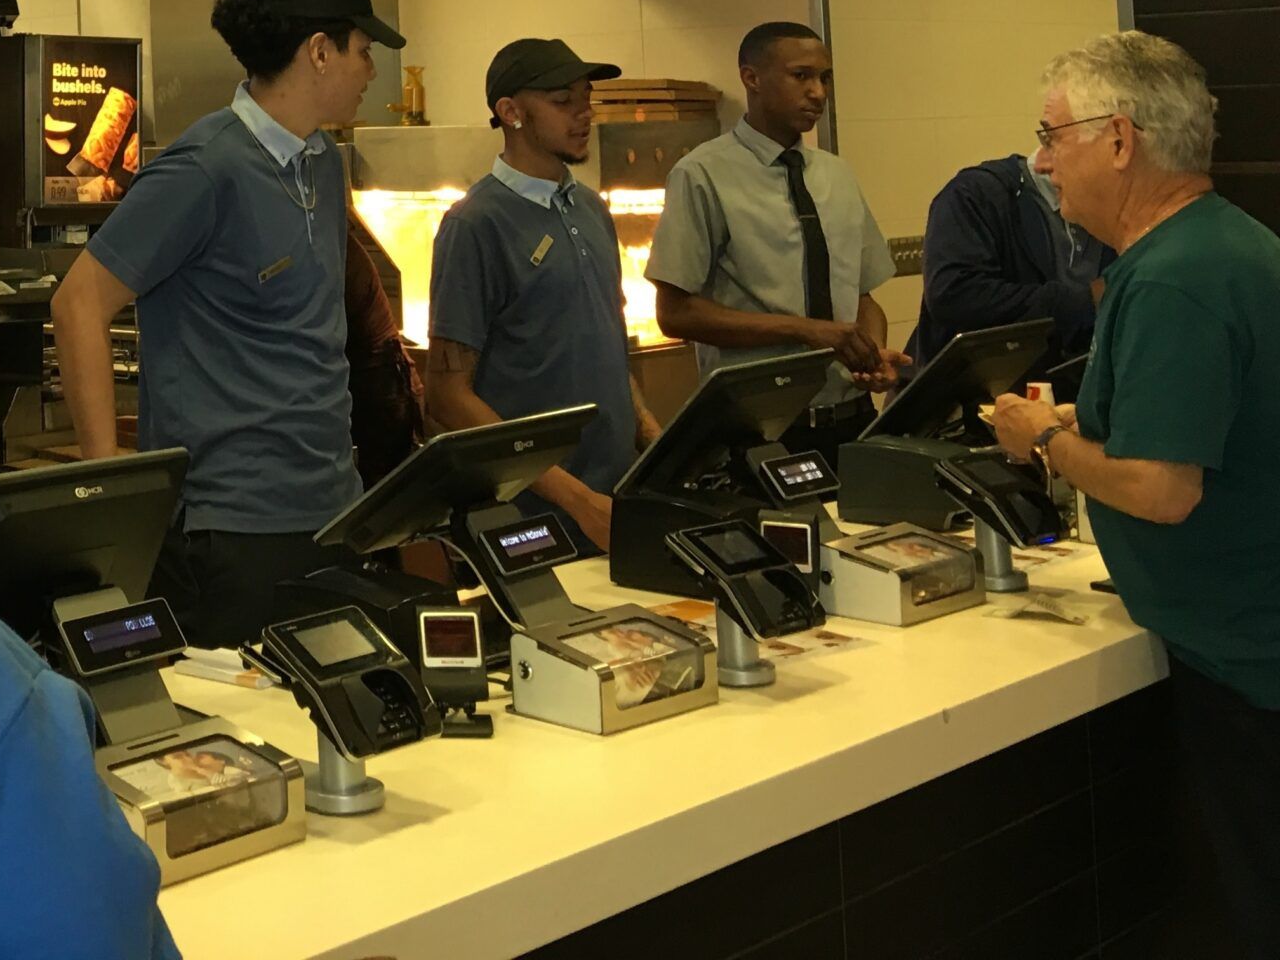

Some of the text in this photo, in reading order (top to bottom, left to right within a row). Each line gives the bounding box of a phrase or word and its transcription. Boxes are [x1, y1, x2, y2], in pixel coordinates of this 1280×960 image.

[52, 63, 107, 78] Bite into
[52, 78, 106, 94] bushels.
[60, 99, 77, 107] Apple
